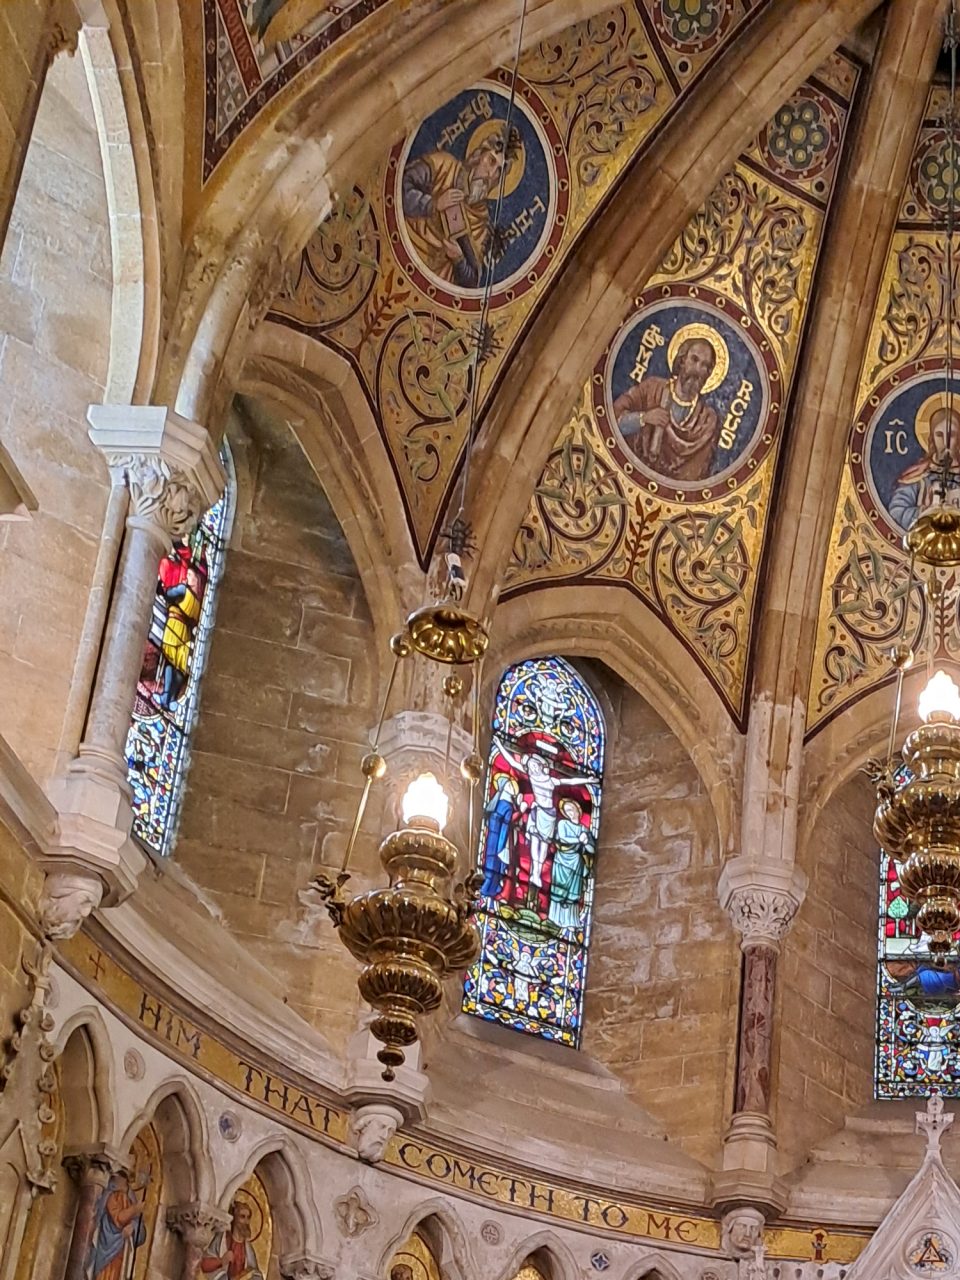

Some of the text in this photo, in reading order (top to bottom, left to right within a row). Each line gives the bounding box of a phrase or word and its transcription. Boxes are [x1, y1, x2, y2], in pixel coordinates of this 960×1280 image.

[139, 991, 339, 1133] HIM THAT
[398, 1142, 698, 1243] COMETH TO ME
